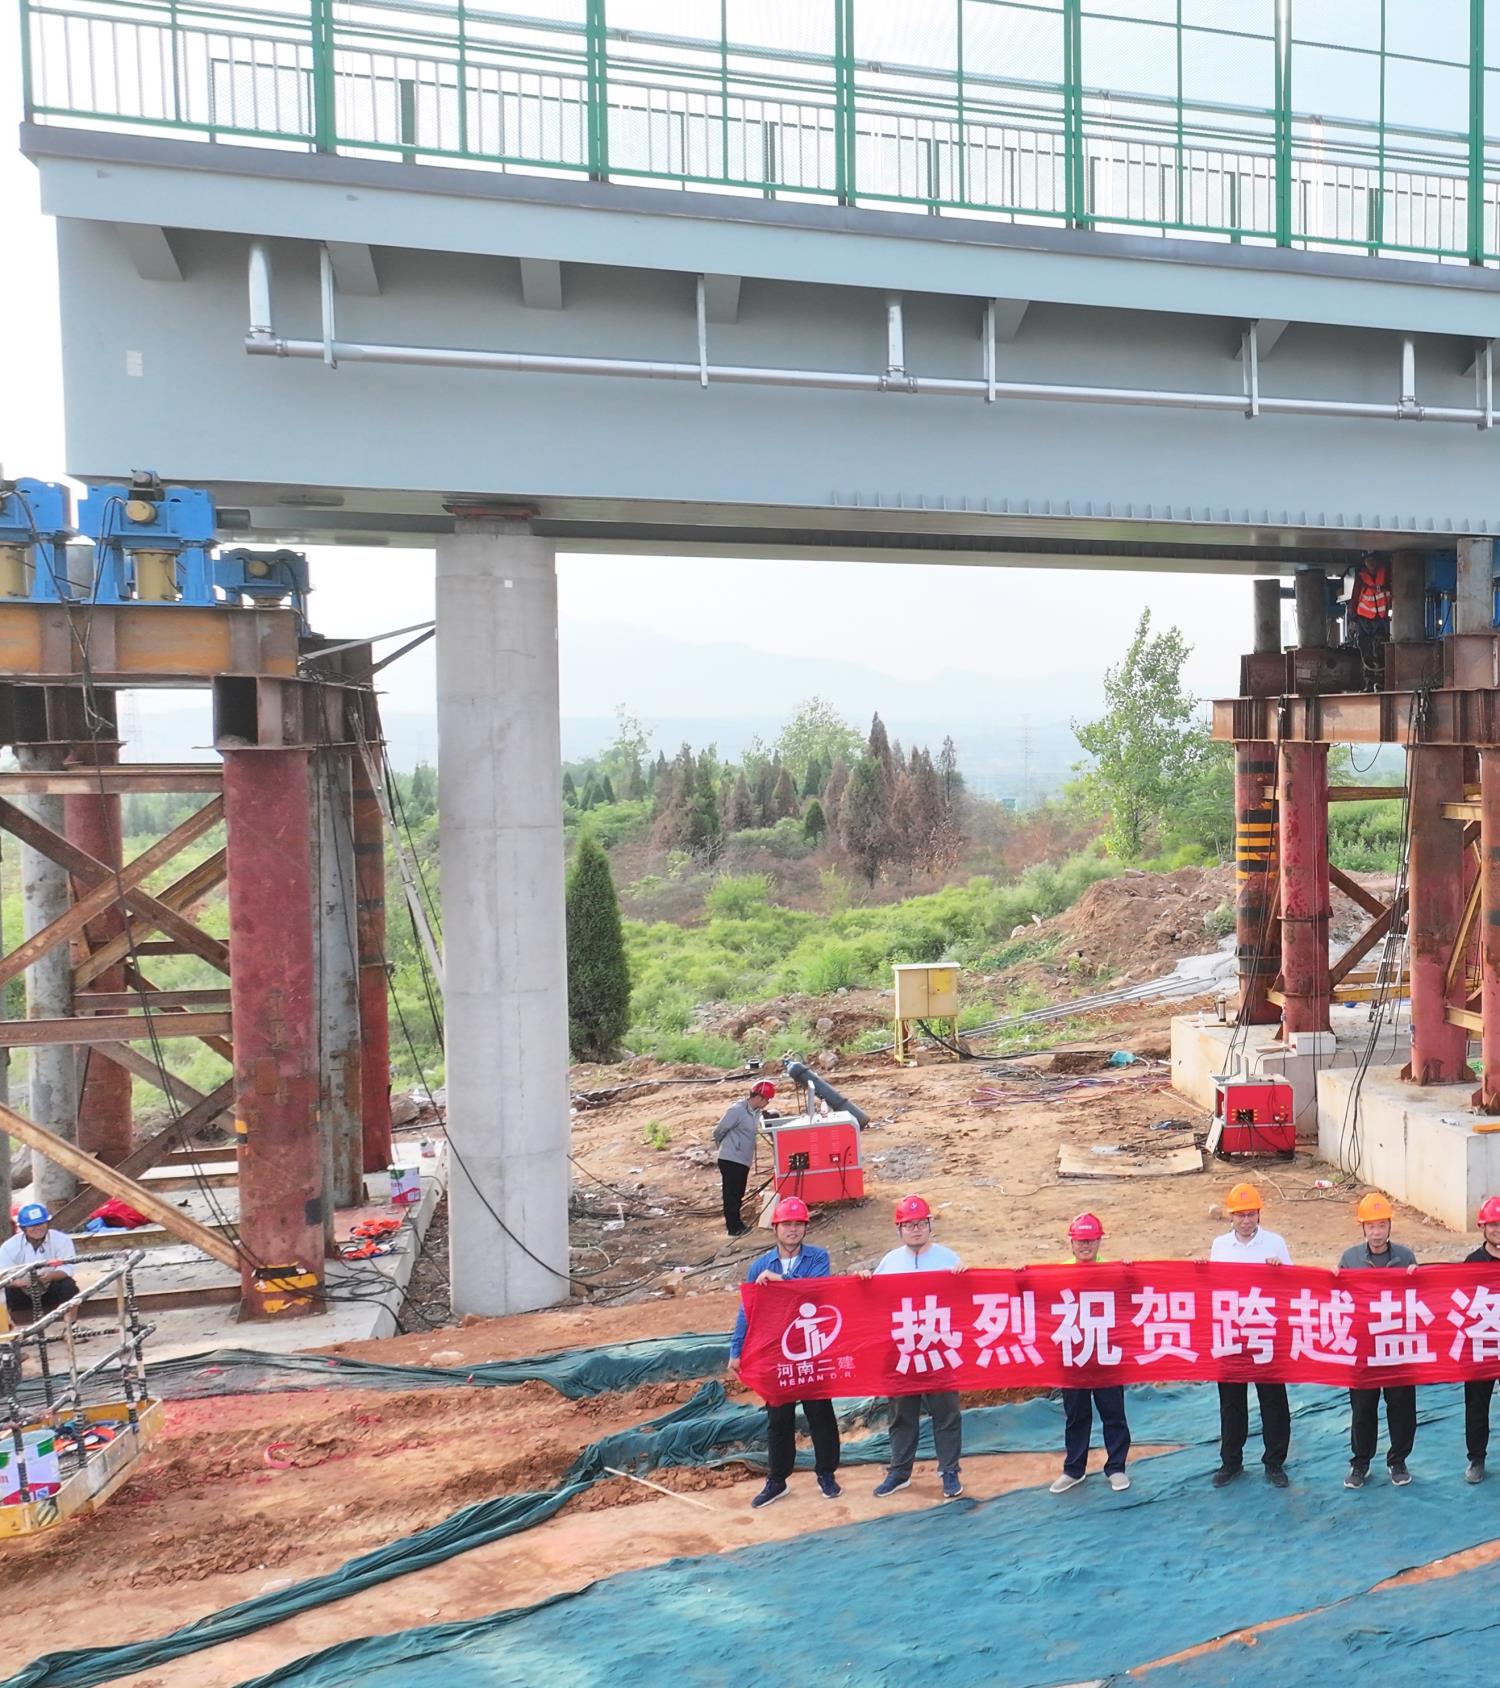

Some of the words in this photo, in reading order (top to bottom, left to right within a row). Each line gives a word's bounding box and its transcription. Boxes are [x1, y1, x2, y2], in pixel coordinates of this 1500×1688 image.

[777, 1355, 856, 1378] 河南二建
[780, 1375, 824, 1387] HENAN
